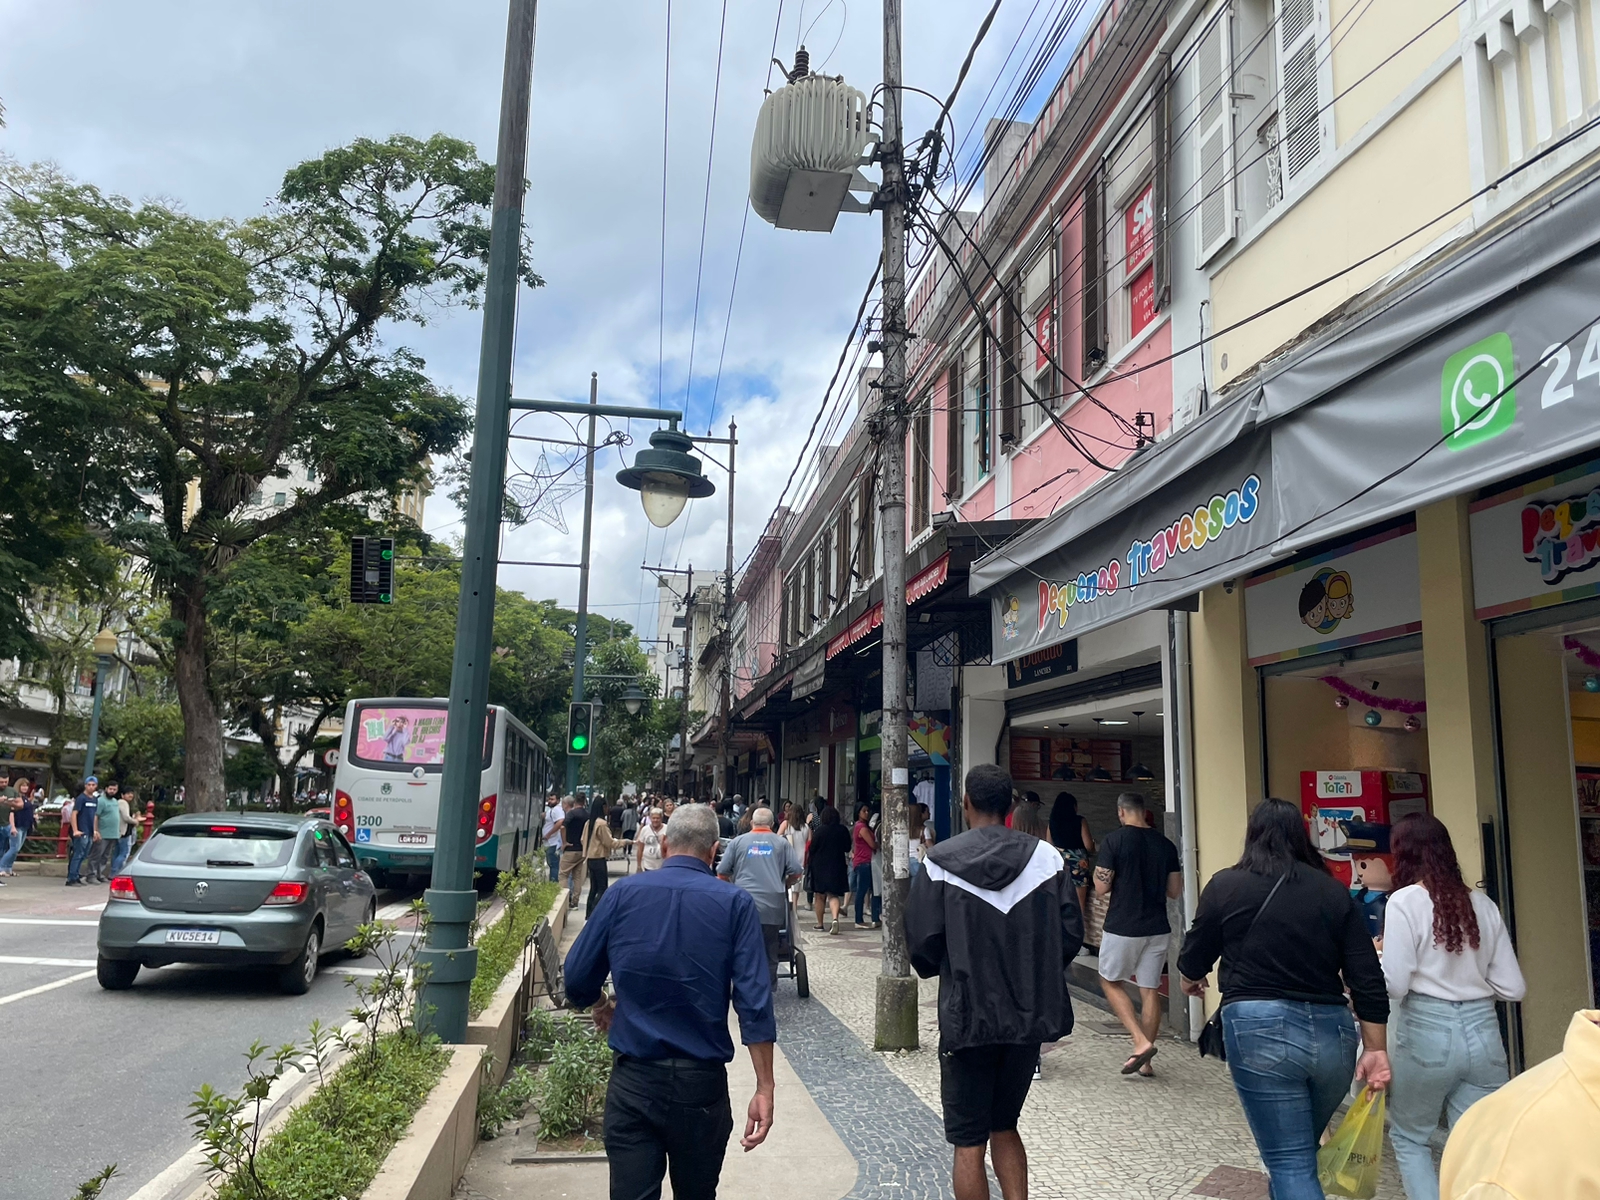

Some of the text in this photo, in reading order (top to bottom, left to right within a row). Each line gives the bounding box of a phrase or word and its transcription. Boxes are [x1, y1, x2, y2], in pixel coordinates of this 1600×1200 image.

[1132, 294, 1138, 305] TV
[1138, 284, 1149, 300] POR
[1037, 559, 1121, 634] Pequenos
[1034, 666, 1052, 677] LANCHES
[356, 815, 382, 827] 1300
[169, 932, 213, 942] KVC5E14
